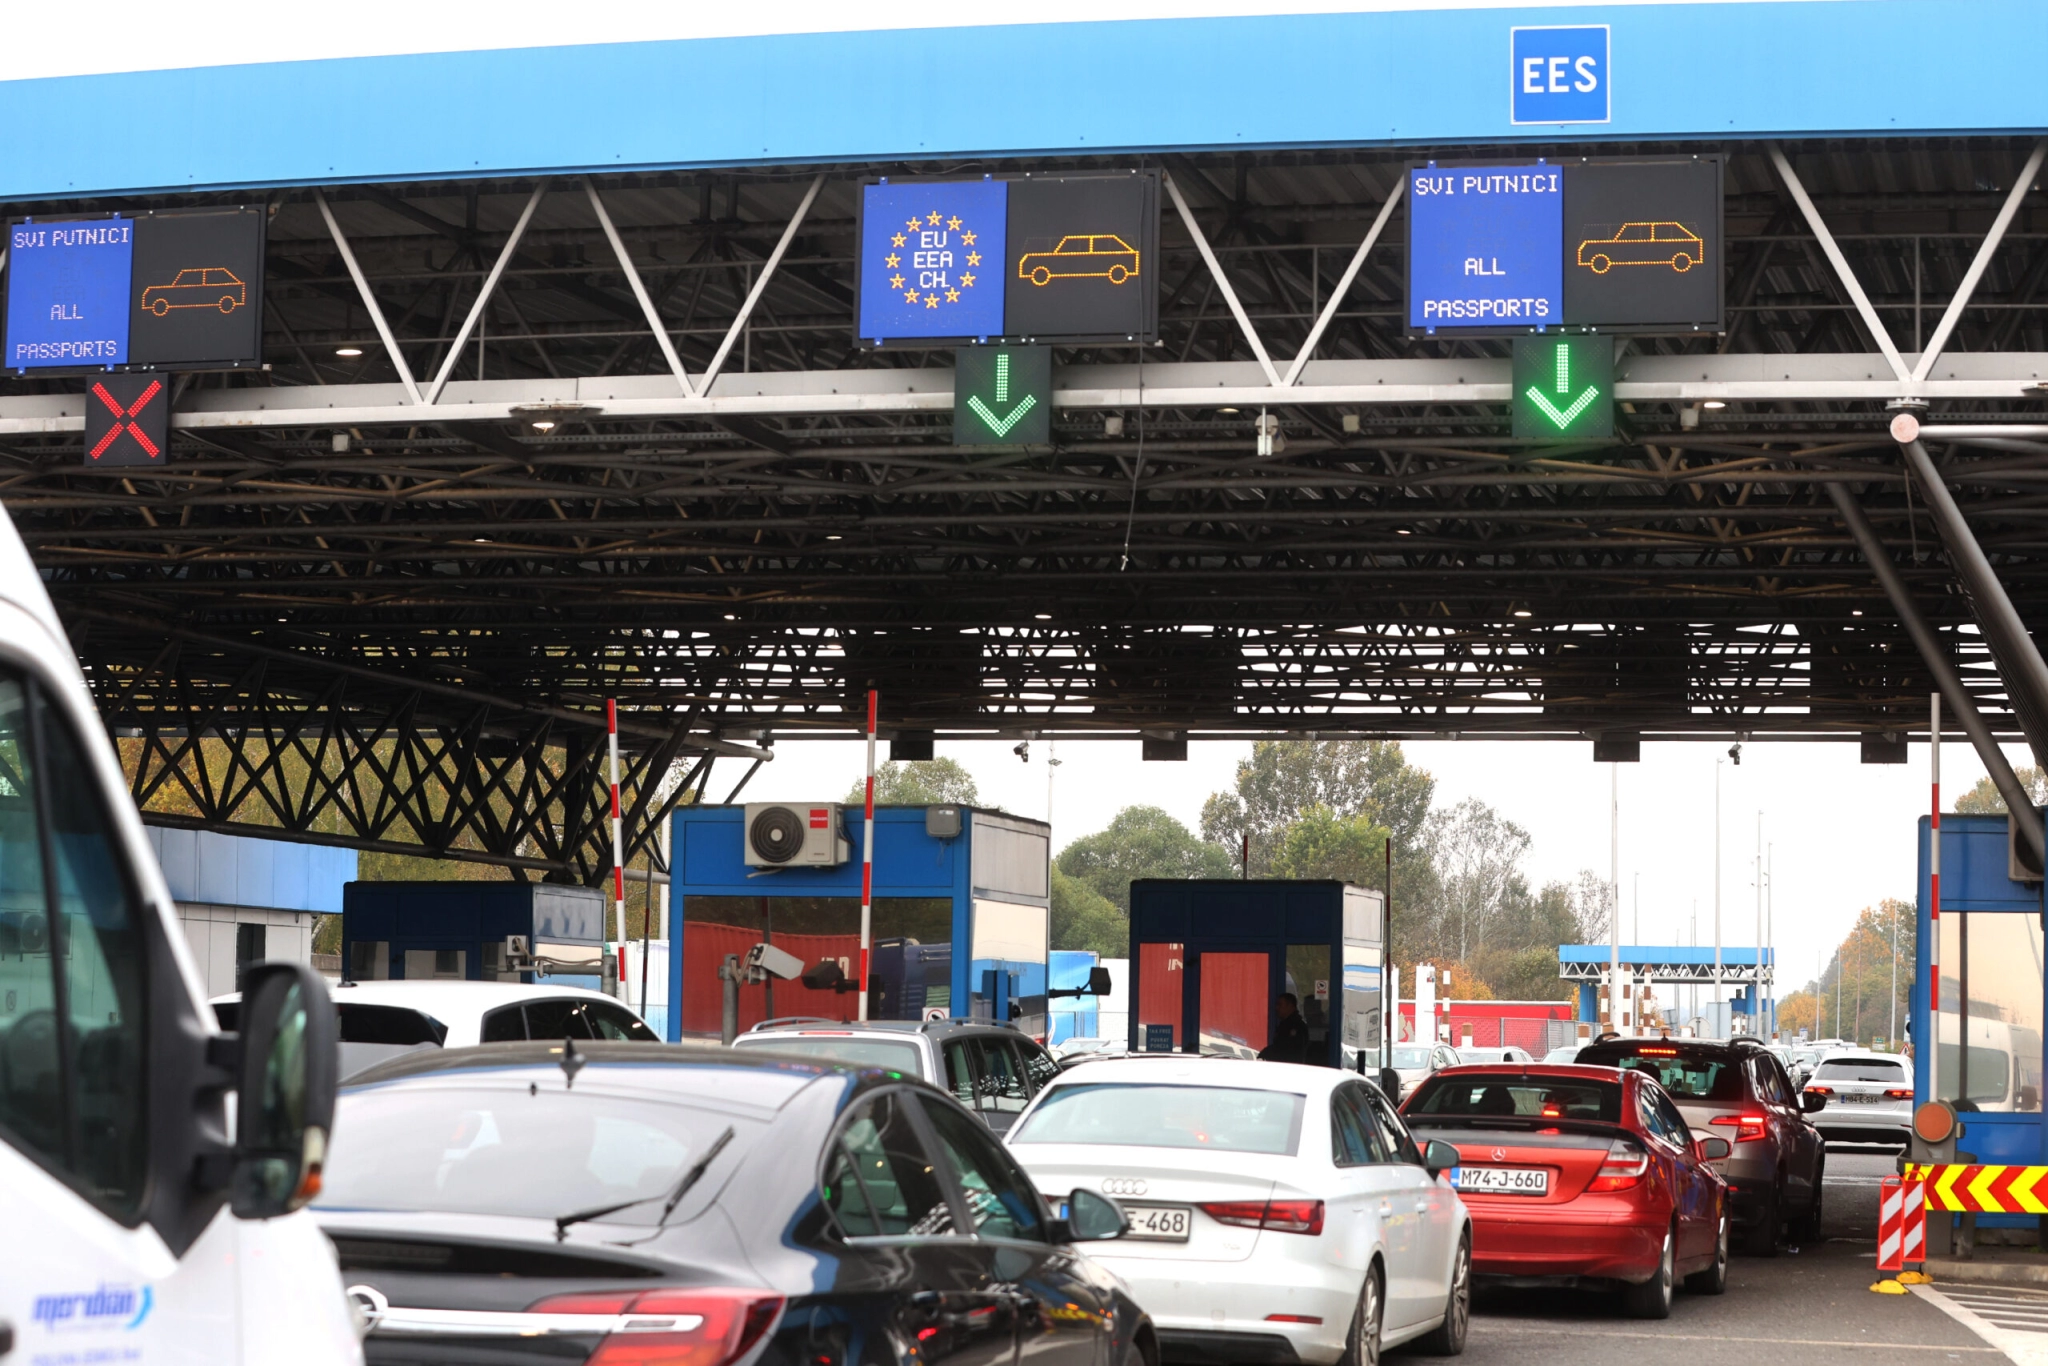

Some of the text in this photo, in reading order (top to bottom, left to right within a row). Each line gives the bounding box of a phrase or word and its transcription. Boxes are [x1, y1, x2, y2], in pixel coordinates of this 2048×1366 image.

[1523, 55, 1597, 93] EES
[1415, 174, 1558, 195] SVI PUTNICI
[14, 227, 130, 248] SVI PUTNICI
[920, 230, 948, 249] EU
[913, 250, 953, 269] EEA
[1464, 257, 1506, 276] ALL
[50, 304, 84, 320] ALL
[1423, 298, 1549, 319] PASSPORTS
[16, 340, 117, 360] PASSPORTS
[1461, 1169, 1544, 1189] M74-J-660
